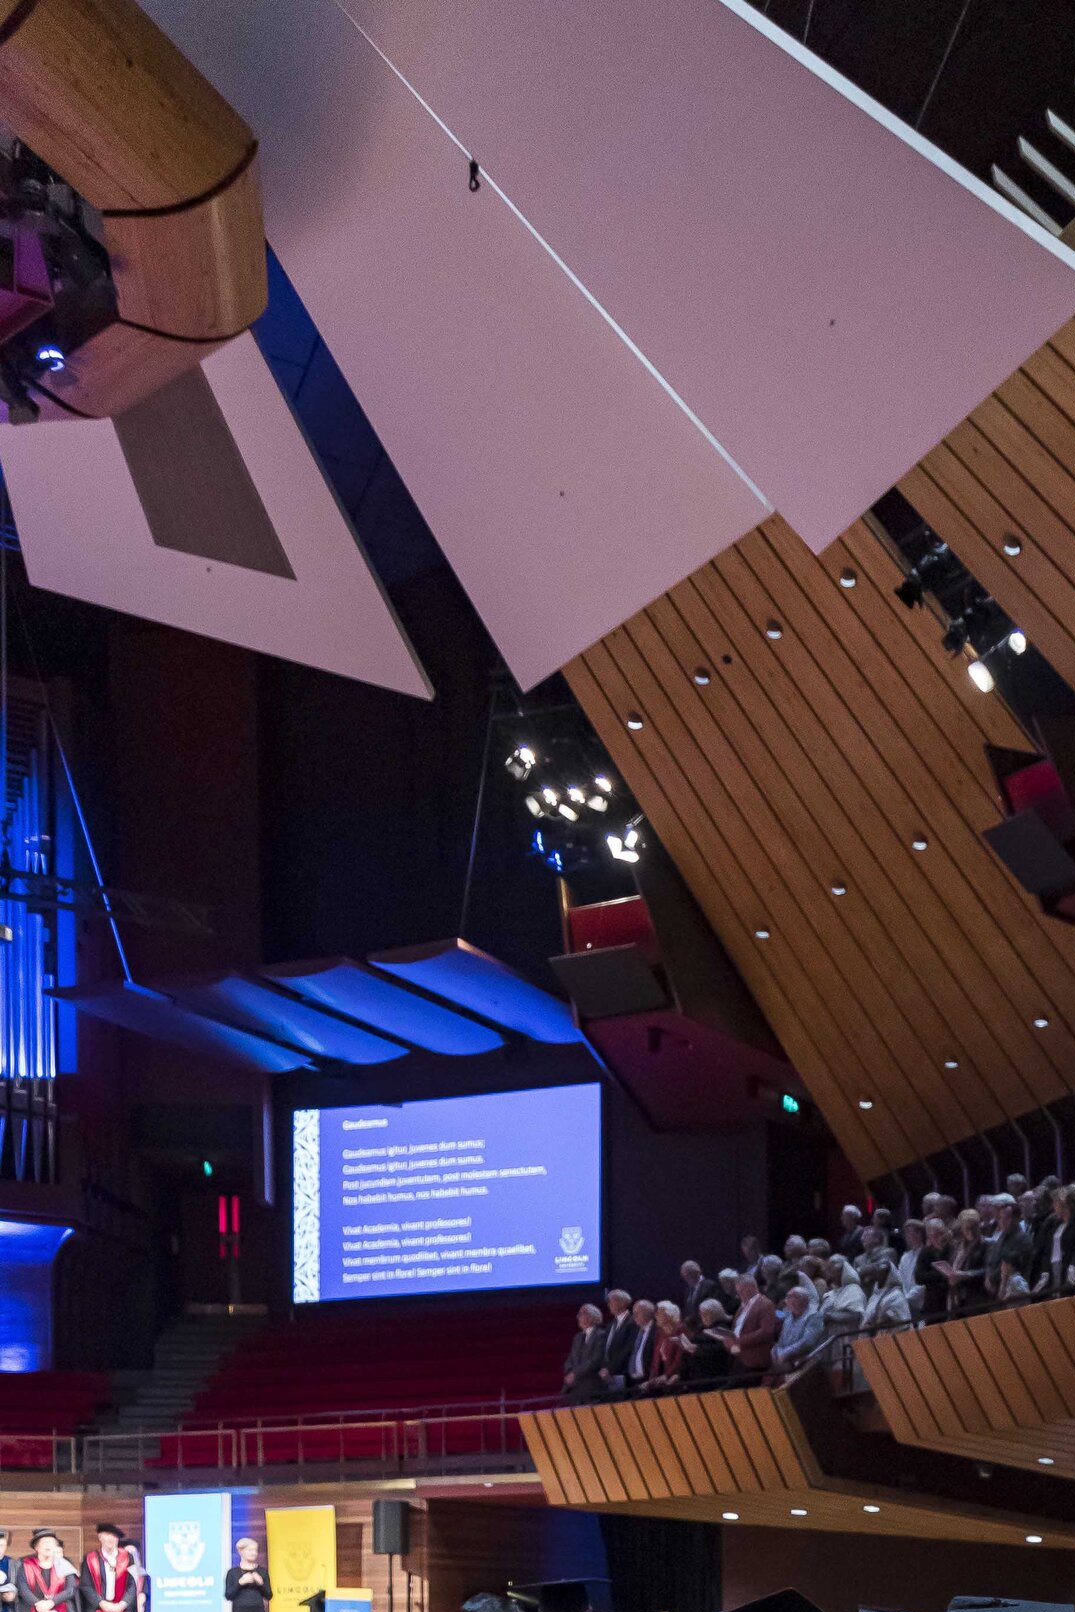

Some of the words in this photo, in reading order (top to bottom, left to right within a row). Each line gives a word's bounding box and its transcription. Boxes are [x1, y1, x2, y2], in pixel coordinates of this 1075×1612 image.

[343, 1119, 388, 1130] Gaudeamus
[342, 1148, 386, 1159] Gaudeamus
[408, 1142, 438, 1154] juvenes
[439, 1140, 456, 1151] dum
[342, 1163, 386, 1175] Gaudeamus
[408, 1158, 438, 1170] juvenes
[439, 1156, 456, 1166] dum
[442, 1172, 460, 1183] post
[342, 1226, 362, 1235] Vivat
[401, 1221, 424, 1231] vivant
[342, 1241, 362, 1251] Vivat
[401, 1236, 424, 1247] vivant
[342, 1258, 362, 1267] Vivat
[440, 1249, 464, 1259] vivant
[342, 1273, 371, 1283] Semper
[416, 1267, 445, 1278] Semper
[156, 1576, 214, 1588] LINCOLN
